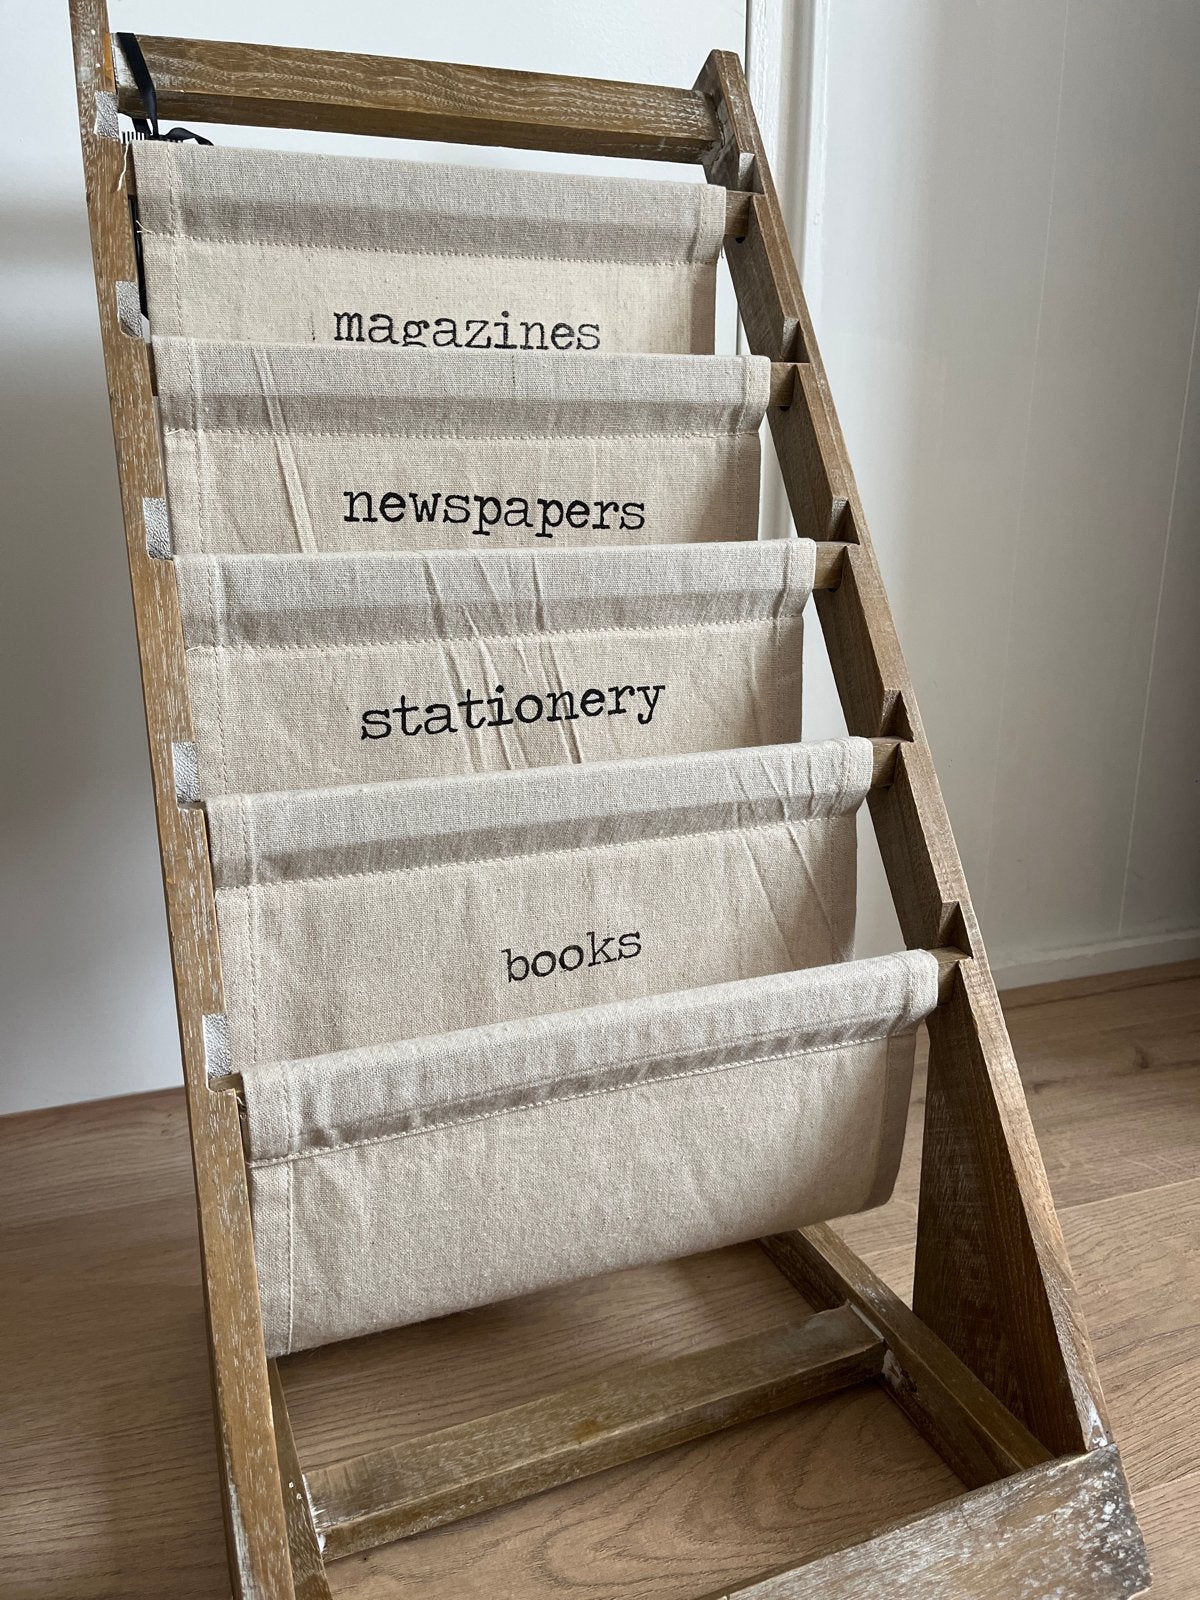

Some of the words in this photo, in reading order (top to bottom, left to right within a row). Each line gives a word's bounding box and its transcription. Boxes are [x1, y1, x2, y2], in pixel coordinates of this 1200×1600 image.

[333, 310, 601, 350] magazines
[343, 491, 646, 538] newspapers
[361, 684, 666, 741] stationery
[501, 931, 642, 983] books
